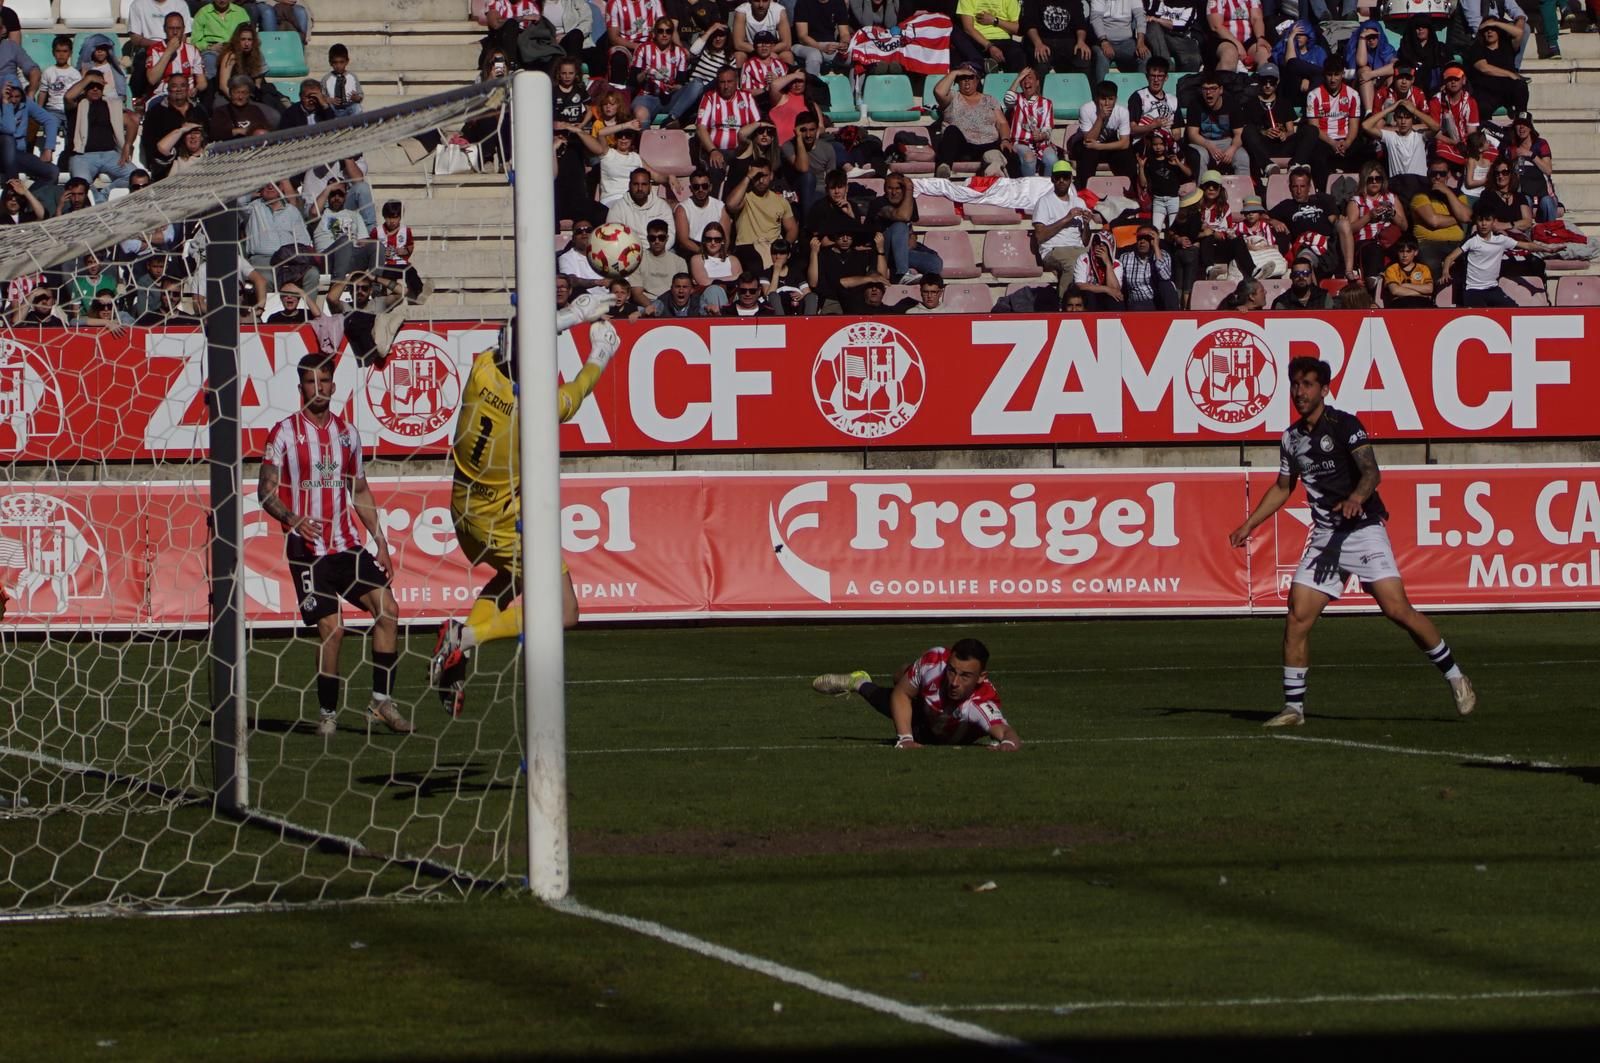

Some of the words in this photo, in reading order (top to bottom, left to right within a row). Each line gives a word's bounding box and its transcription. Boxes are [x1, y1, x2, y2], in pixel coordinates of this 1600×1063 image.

[628, 324, 787, 443] CF
[970, 316, 1424, 436] ZAMORA
[1432, 315, 1585, 431] CF
[829, 412, 888, 437] ZAMORA
[889, 406, 910, 429] C.F.
[1198, 401, 1247, 422] ZAMORA
[1247, 398, 1265, 416] C.F.
[470, 415, 493, 467] 1
[849, 481, 1181, 565] Freigel
[1416, 480, 1514, 547] E.S.
[845, 582, 859, 595] A
[869, 579, 979, 595] GOODLIFE
[989, 578, 1063, 594] FOODS
[1072, 577, 1182, 593] COMPANY
